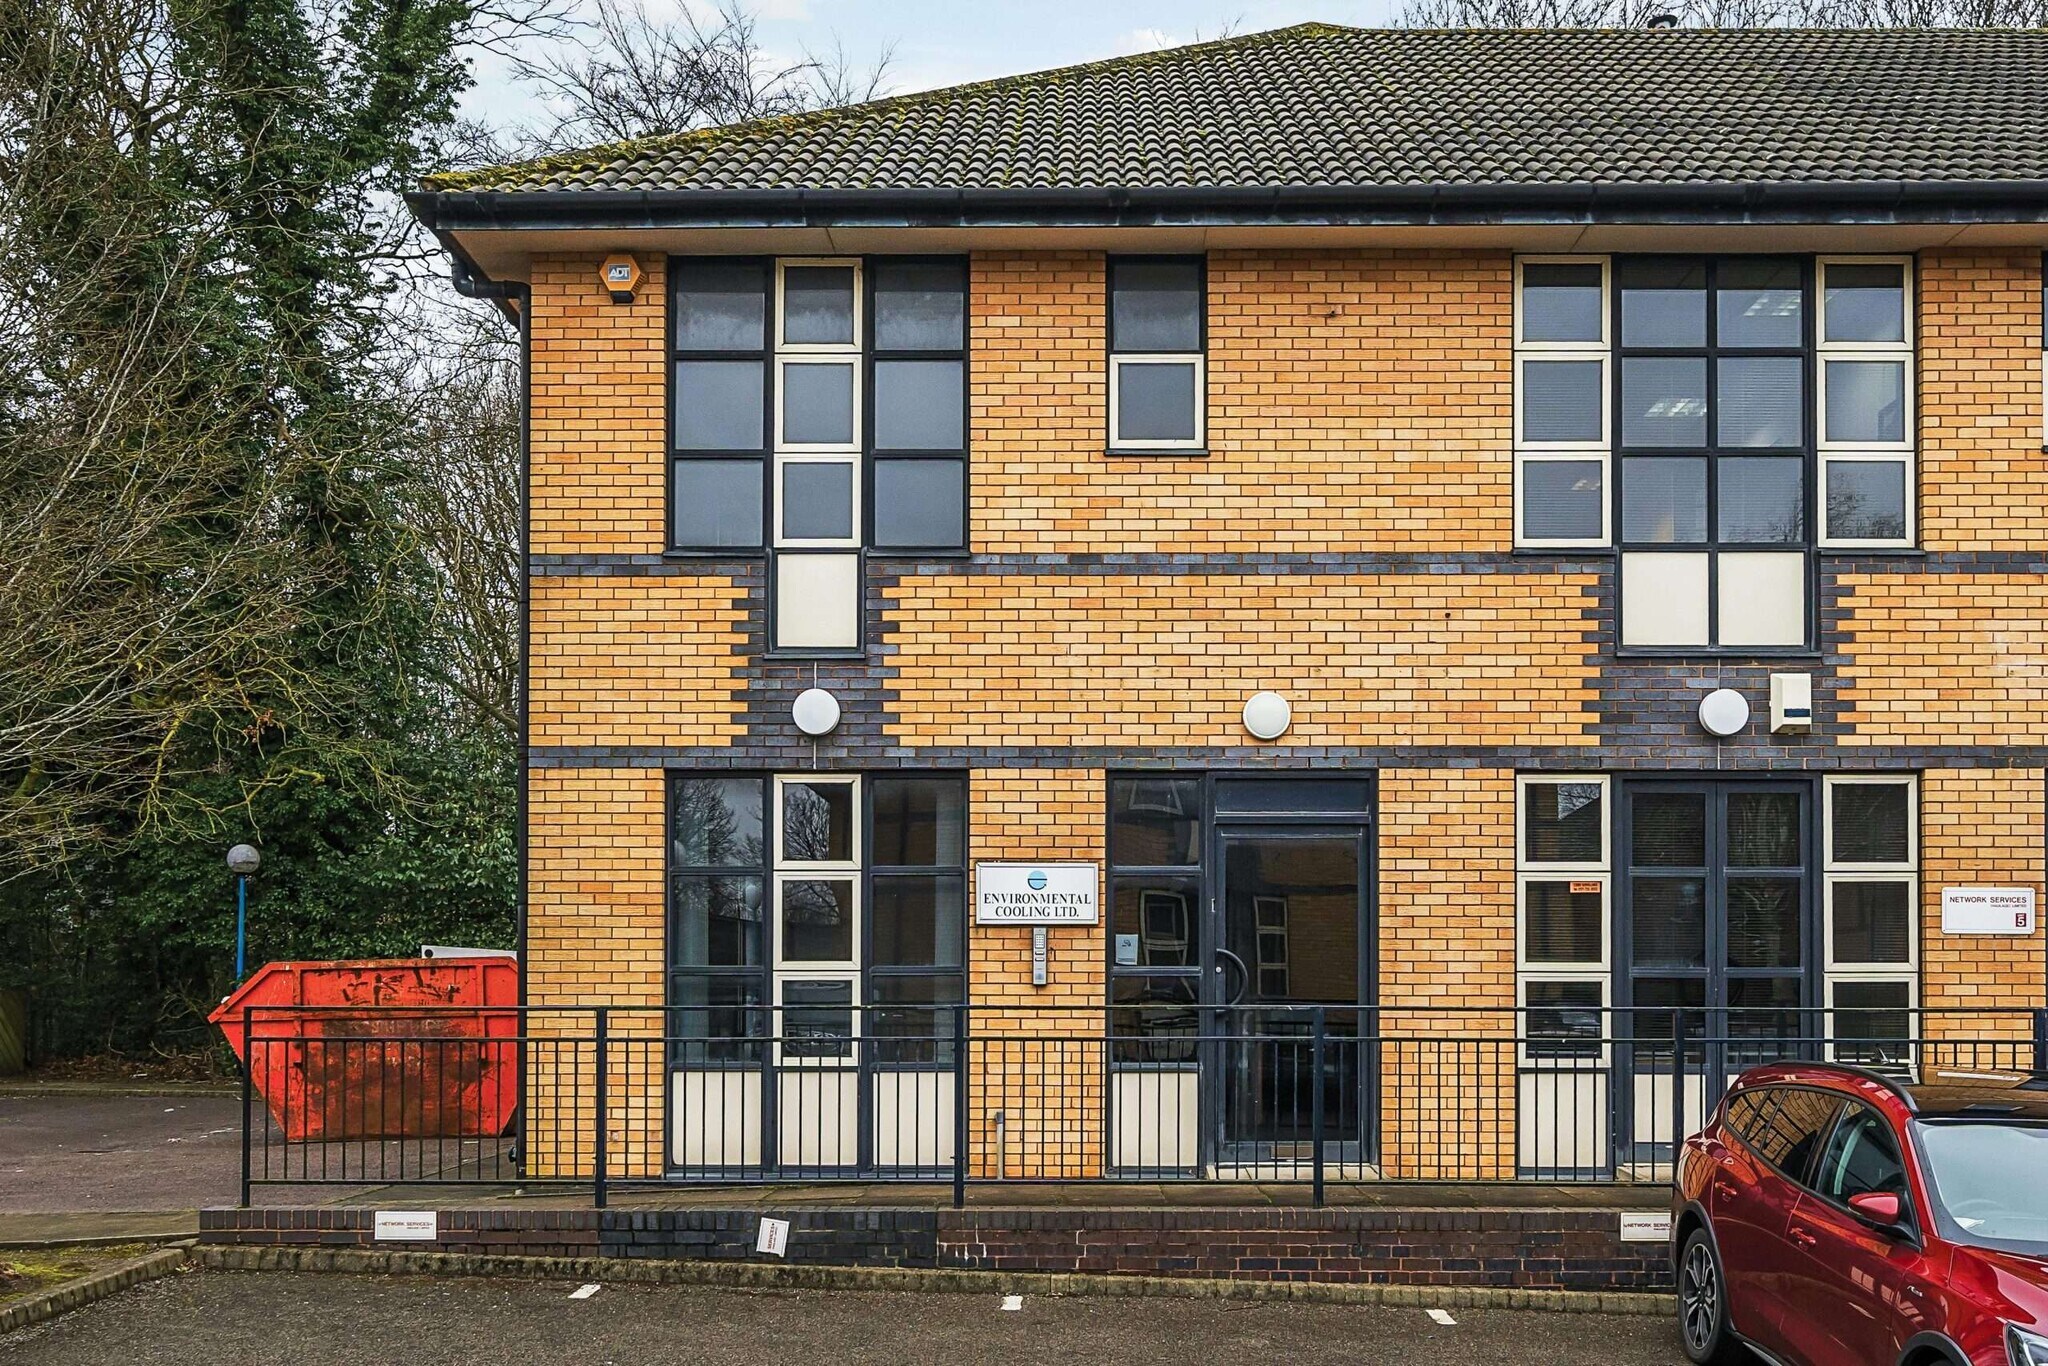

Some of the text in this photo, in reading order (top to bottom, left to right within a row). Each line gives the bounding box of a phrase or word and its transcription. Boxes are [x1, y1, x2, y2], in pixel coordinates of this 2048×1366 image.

[610, 267, 630, 278] ADT
[983, 893, 1092, 904] ENVIRONMENTAL
[1989, 896, 2027, 904] SERVICES
[995, 905, 1080, 917] COOLING LTD.
[2017, 916, 2026, 927] 5
